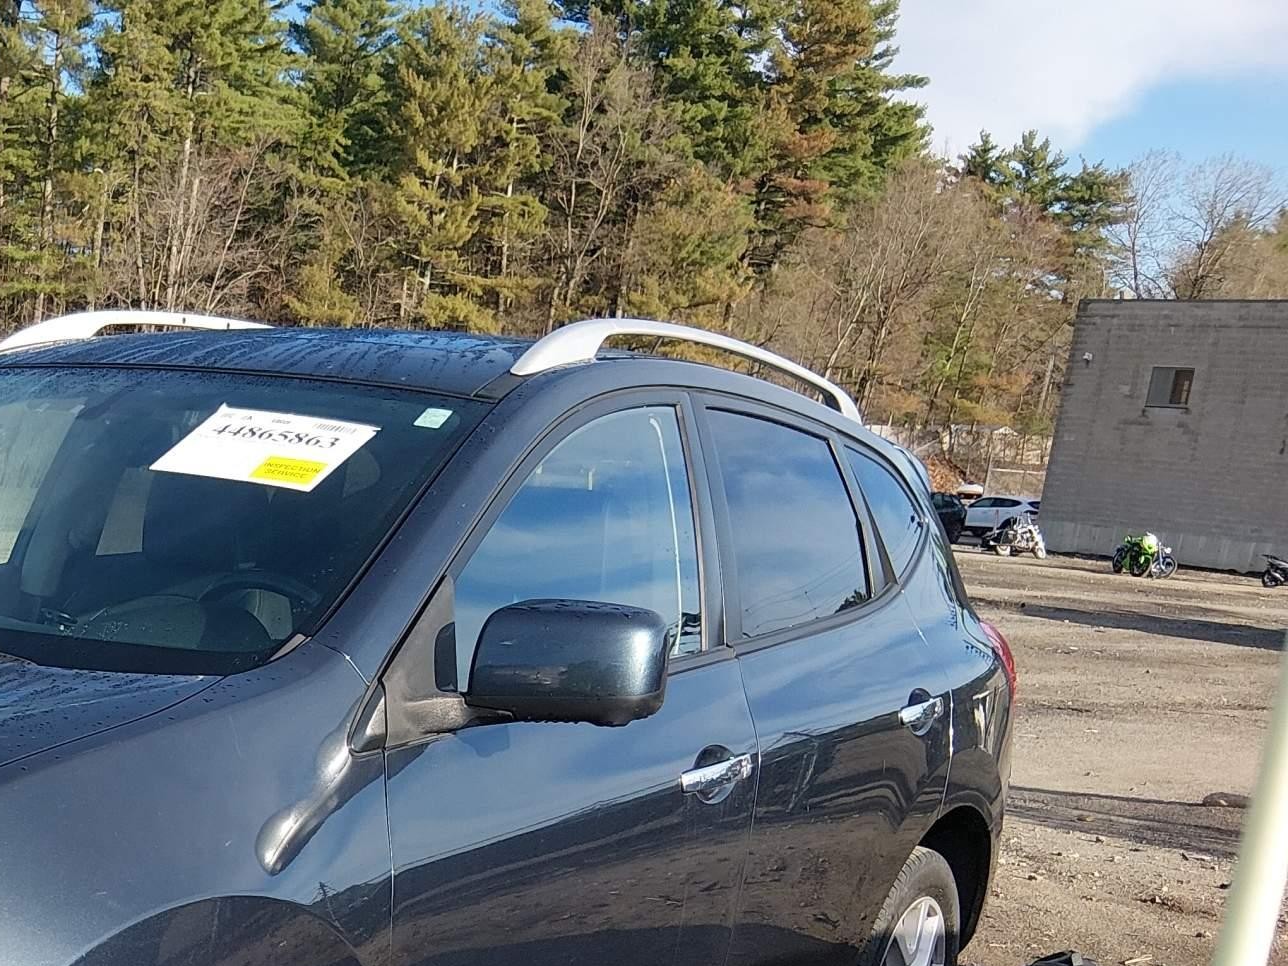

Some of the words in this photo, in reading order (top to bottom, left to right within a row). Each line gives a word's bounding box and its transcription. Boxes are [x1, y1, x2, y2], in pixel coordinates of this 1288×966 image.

[213, 423, 340, 449] 44865863
[264, 462, 320, 474] INSPECTION
[264, 469, 309, 479] SERVICE
